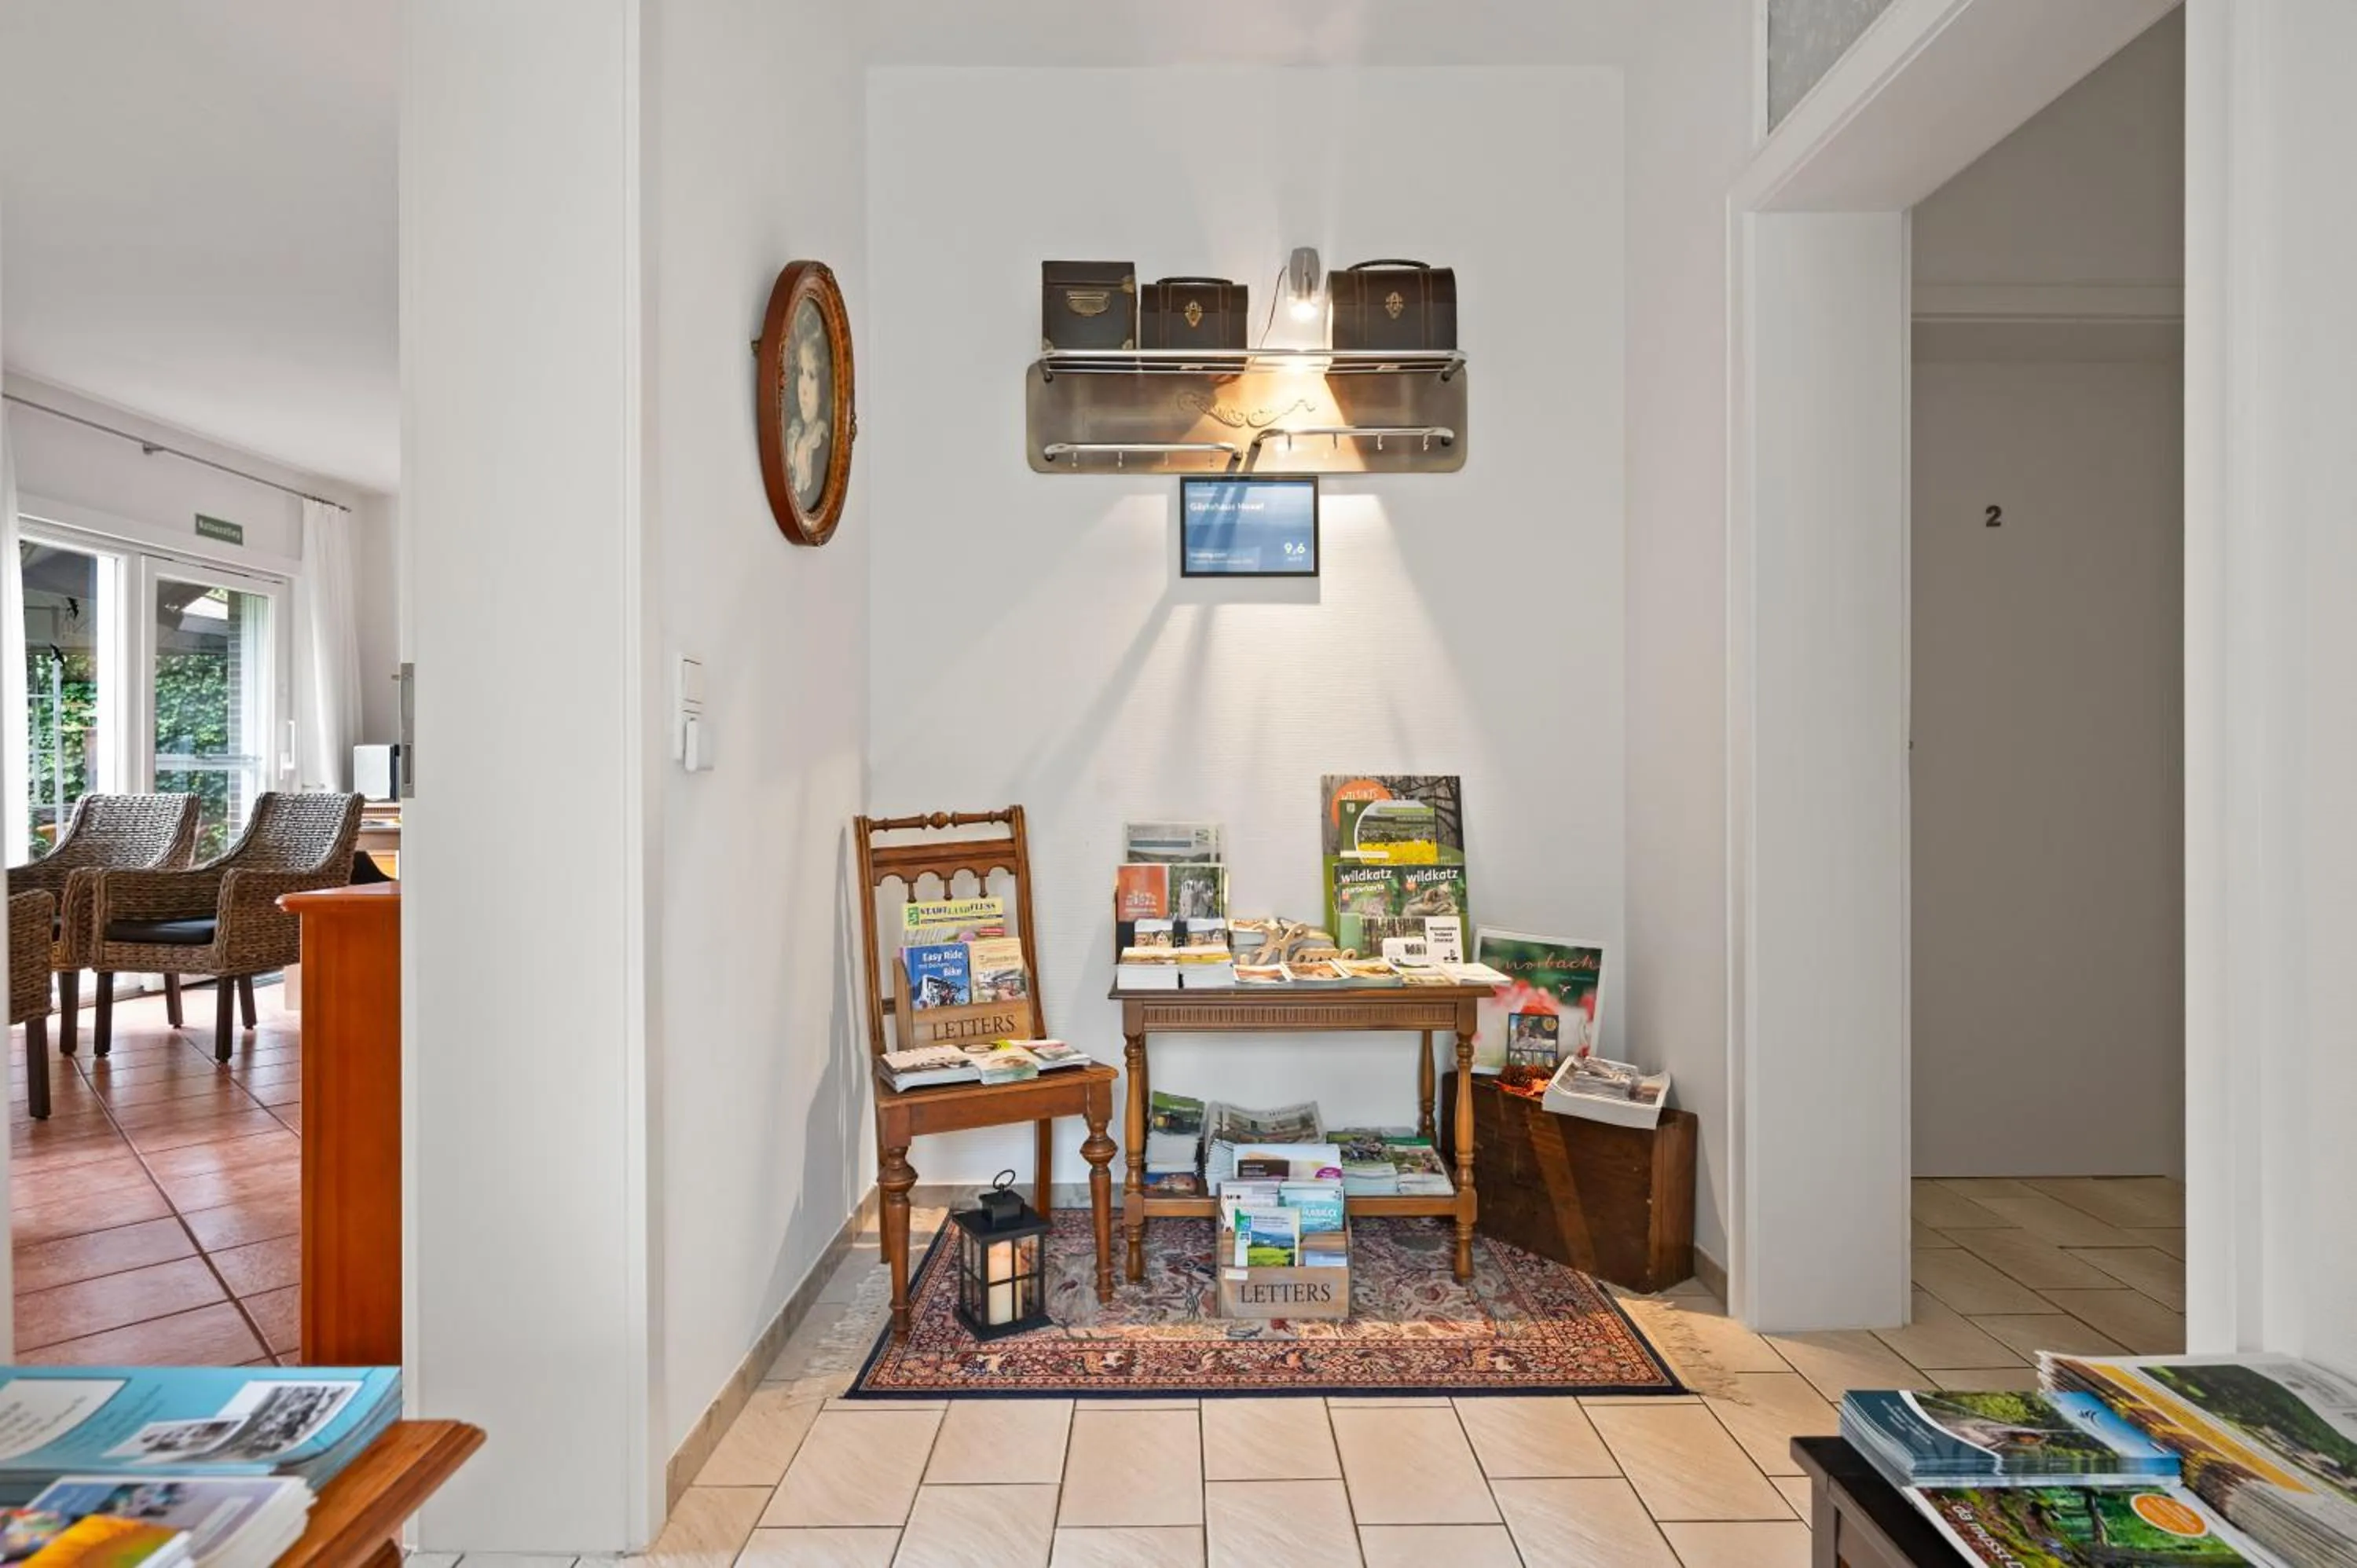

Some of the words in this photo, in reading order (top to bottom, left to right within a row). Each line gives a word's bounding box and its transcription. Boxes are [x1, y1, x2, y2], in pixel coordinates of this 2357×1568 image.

[1985, 505, 2002, 527] 2
[922, 952, 943, 962] Easy
[944, 950, 962, 959] Ride
[944, 966, 962, 976] Bike
[933, 1014, 1016, 1041] LETTERS
[1241, 1283, 1331, 1303] LETTERS
